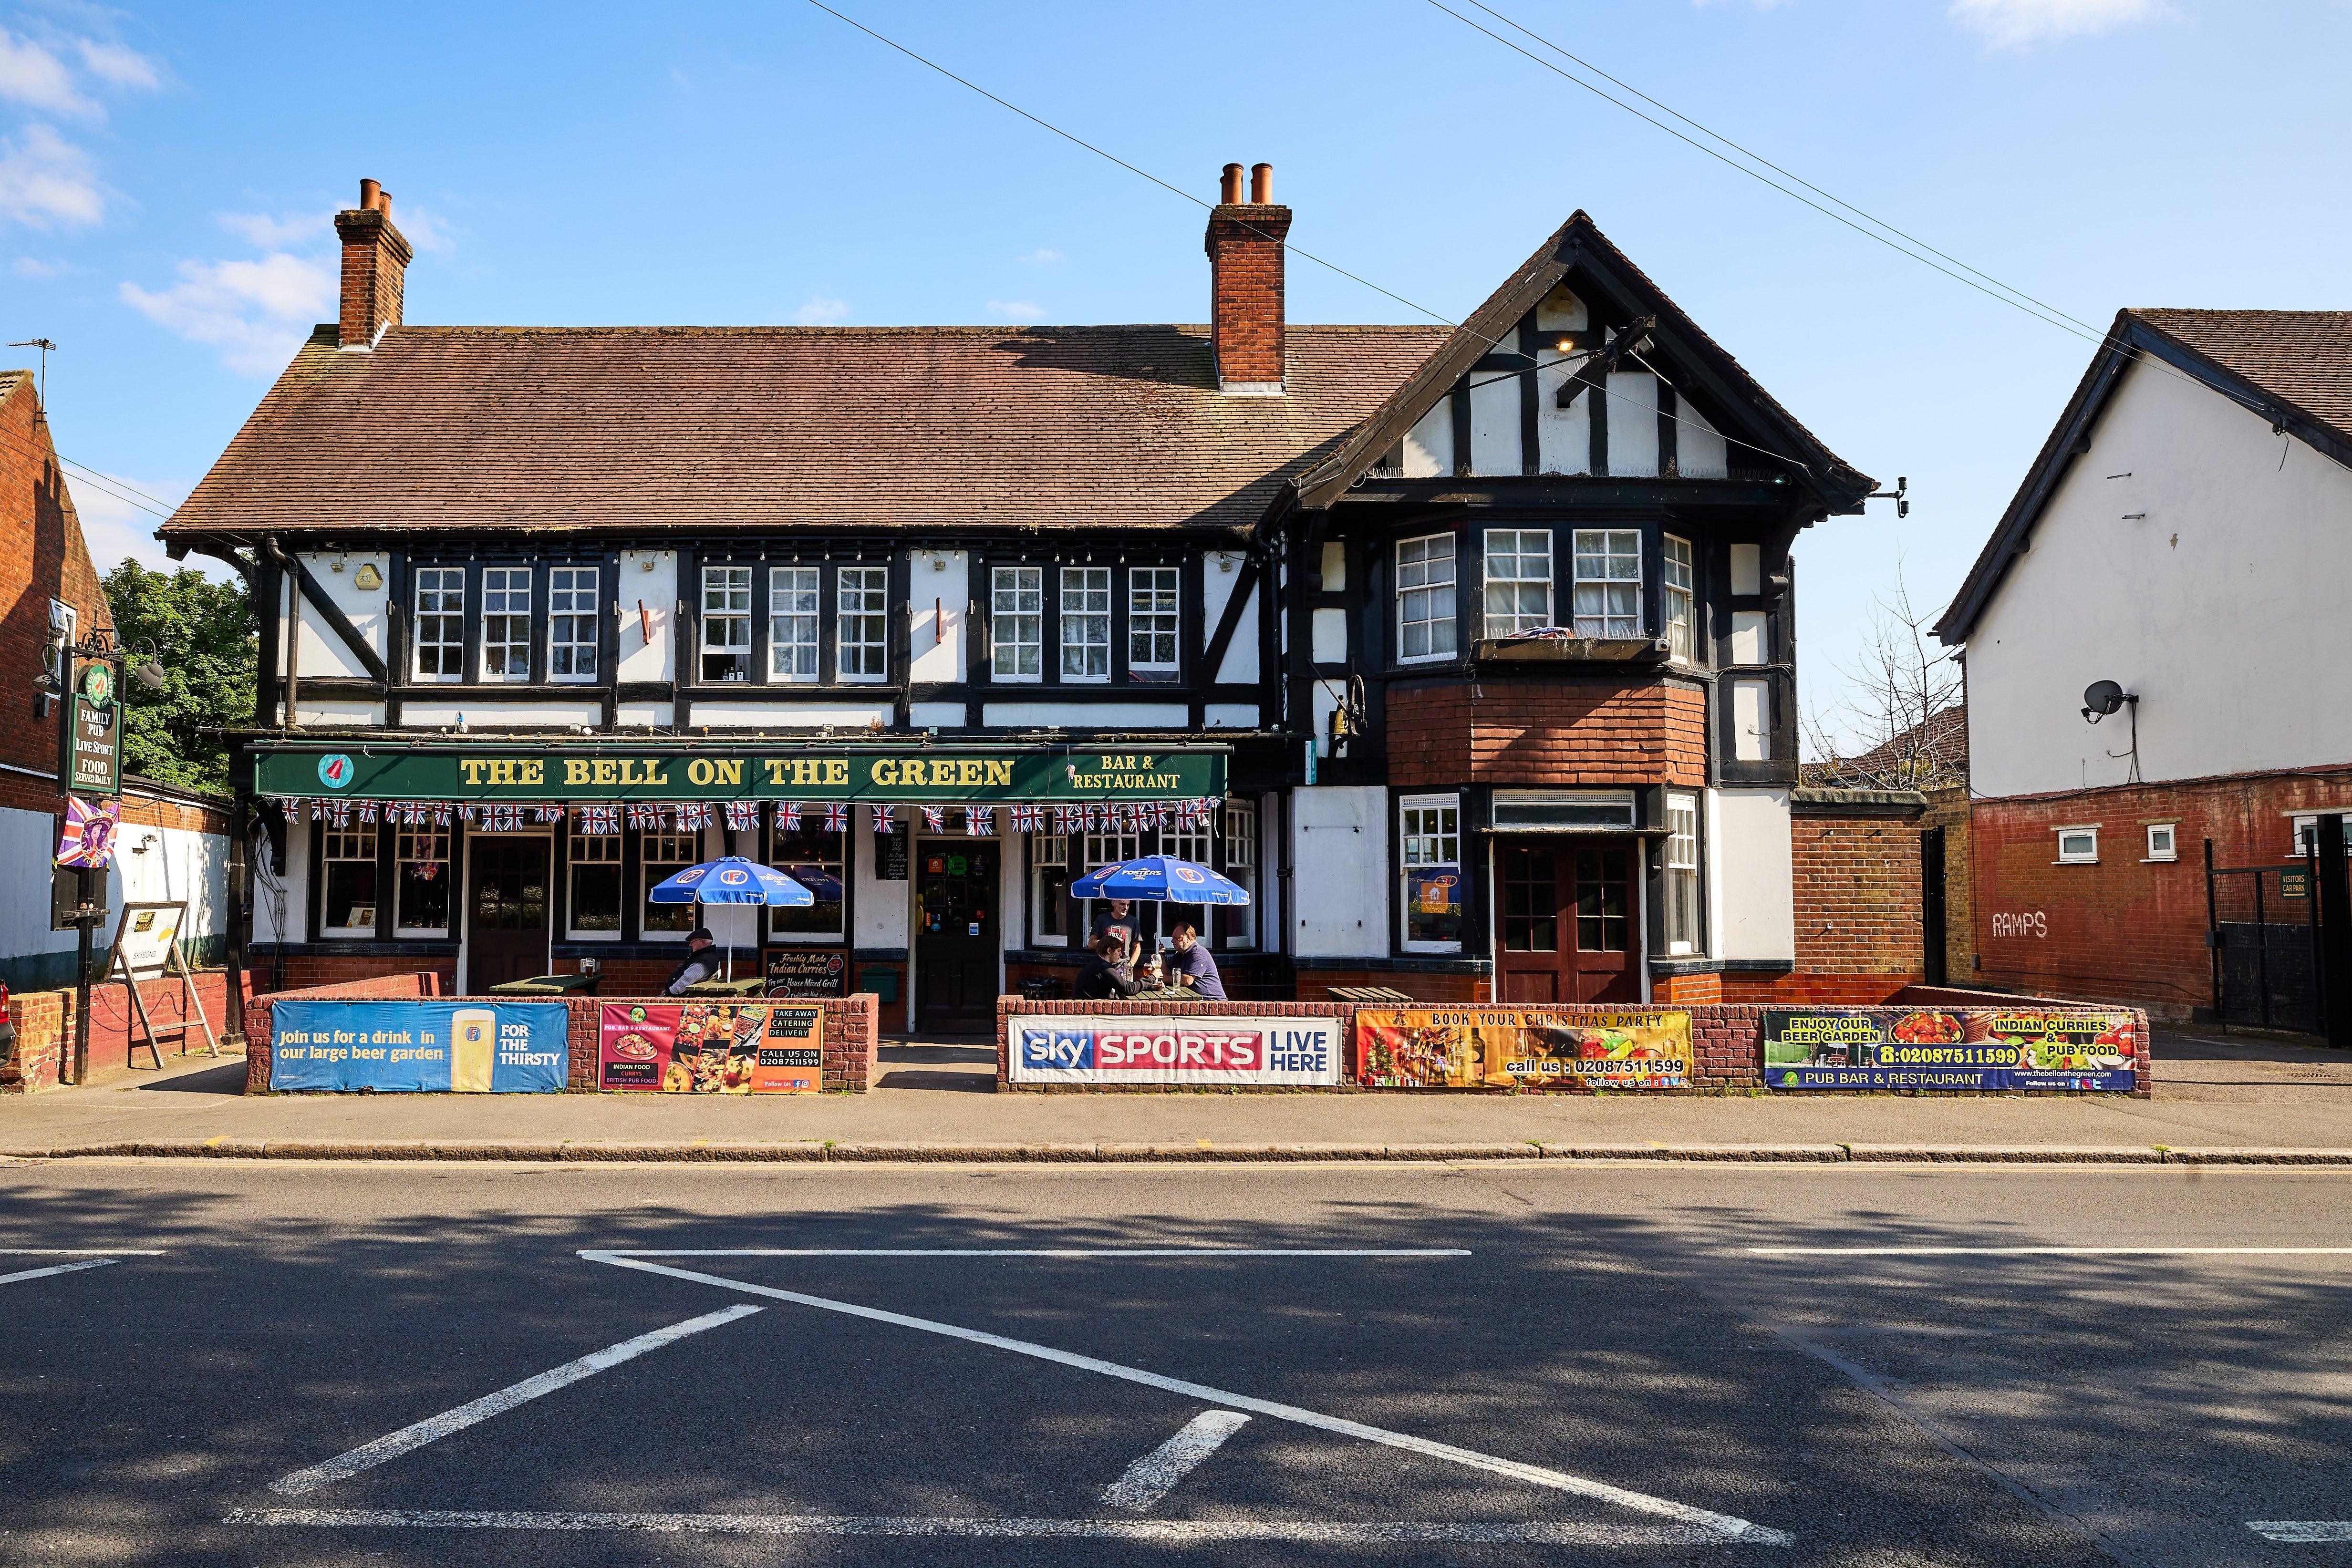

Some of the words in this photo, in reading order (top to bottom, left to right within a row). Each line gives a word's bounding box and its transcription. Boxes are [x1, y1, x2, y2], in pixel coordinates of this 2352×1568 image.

[101, 697, 110, 707] THE
[81, 709, 111, 725] FAMILY
[87, 723, 104, 737] PUB
[82, 759, 108, 775] FOOD
[1101, 755, 1136, 770] BAR
[1142, 755, 1154, 770] &
[75, 771, 95, 784] SERVED
[95, 774, 112, 785] DAILY
[461, 759, 544, 785] THE
[564, 759, 667, 785] BELL
[687, 759, 745, 785] ON
[765, 760, 849, 785] THE
[871, 760, 1015, 786] GREEN
[1073, 774, 1181, 788] RESTAURANT
[727, 872, 742, 882] F
[1993, 911, 2047, 938] RAMPS
[133, 950, 156, 959] SKYBOND
[779, 953, 807, 964] Freshly
[807, 954, 827, 963] Made
[768, 963, 797, 974] Indian
[798, 964, 827, 974] Curries
[787, 978, 805, 987] House
[804, 978, 822, 987] Mixed
[822, 979, 839, 988] Grill
[1431, 1012, 1470, 1027] BOOK
[1478, 1013, 1517, 1027] YOUR
[1525, 1014, 1608, 1028] CHRISTMAS
[1616, 1014, 1663, 1028] PARTY
[1791, 1019, 1837, 1029] ENJOY
[1840, 1019, 1870, 1029] OUR
[1995, 1020, 2042, 1030] INDIAN
[2046, 1021, 2107, 1031] CURRIES
[501, 1024, 529, 1037] FOR
[1782, 1031, 1818, 1042] BEER
[1822, 1031, 1879, 1042] GARDEN
[279, 1030, 309, 1046] Join
[313, 1032, 330, 1043] us
[334, 1030, 356, 1043] for
[359, 1032, 368, 1043] a
[372, 1030, 412, 1044] drink
[420, 1030, 435, 1044] in
[499, 1038, 528, 1051] THE
[1271, 1031, 1327, 1052] LIVE
[2046, 1034, 2056, 1043] &
[280, 1048, 306, 1059] our
[310, 1045, 348, 1063] large
[352, 1046, 387, 1060] beer
[390, 1046, 443, 1063] garden
[1029, 1031, 1088, 1067] sky
[1100, 1035, 1255, 1064] SPORTS
[2046, 1045, 2076, 1055] PUB
[2080, 1045, 2117, 1056] FOOD
[499, 1052, 561, 1065] THIRSTY
[1271, 1052, 1327, 1072] HERE
[1505, 1059, 1536, 1073] call
[1540, 1062, 1561, 1073] us
[1575, 1059, 1684, 1073] 02087511599
[1805, 1073, 1835, 1084] PUB
[1839, 1073, 1869, 1084] BAR
[1875, 1073, 1885, 1084] &
[1889, 1073, 1984, 1085] RESTAURANT
[2014, 1070, 2112, 1078] www.thebellonthegreen.com
[1586, 1077, 1619, 1086] follow
